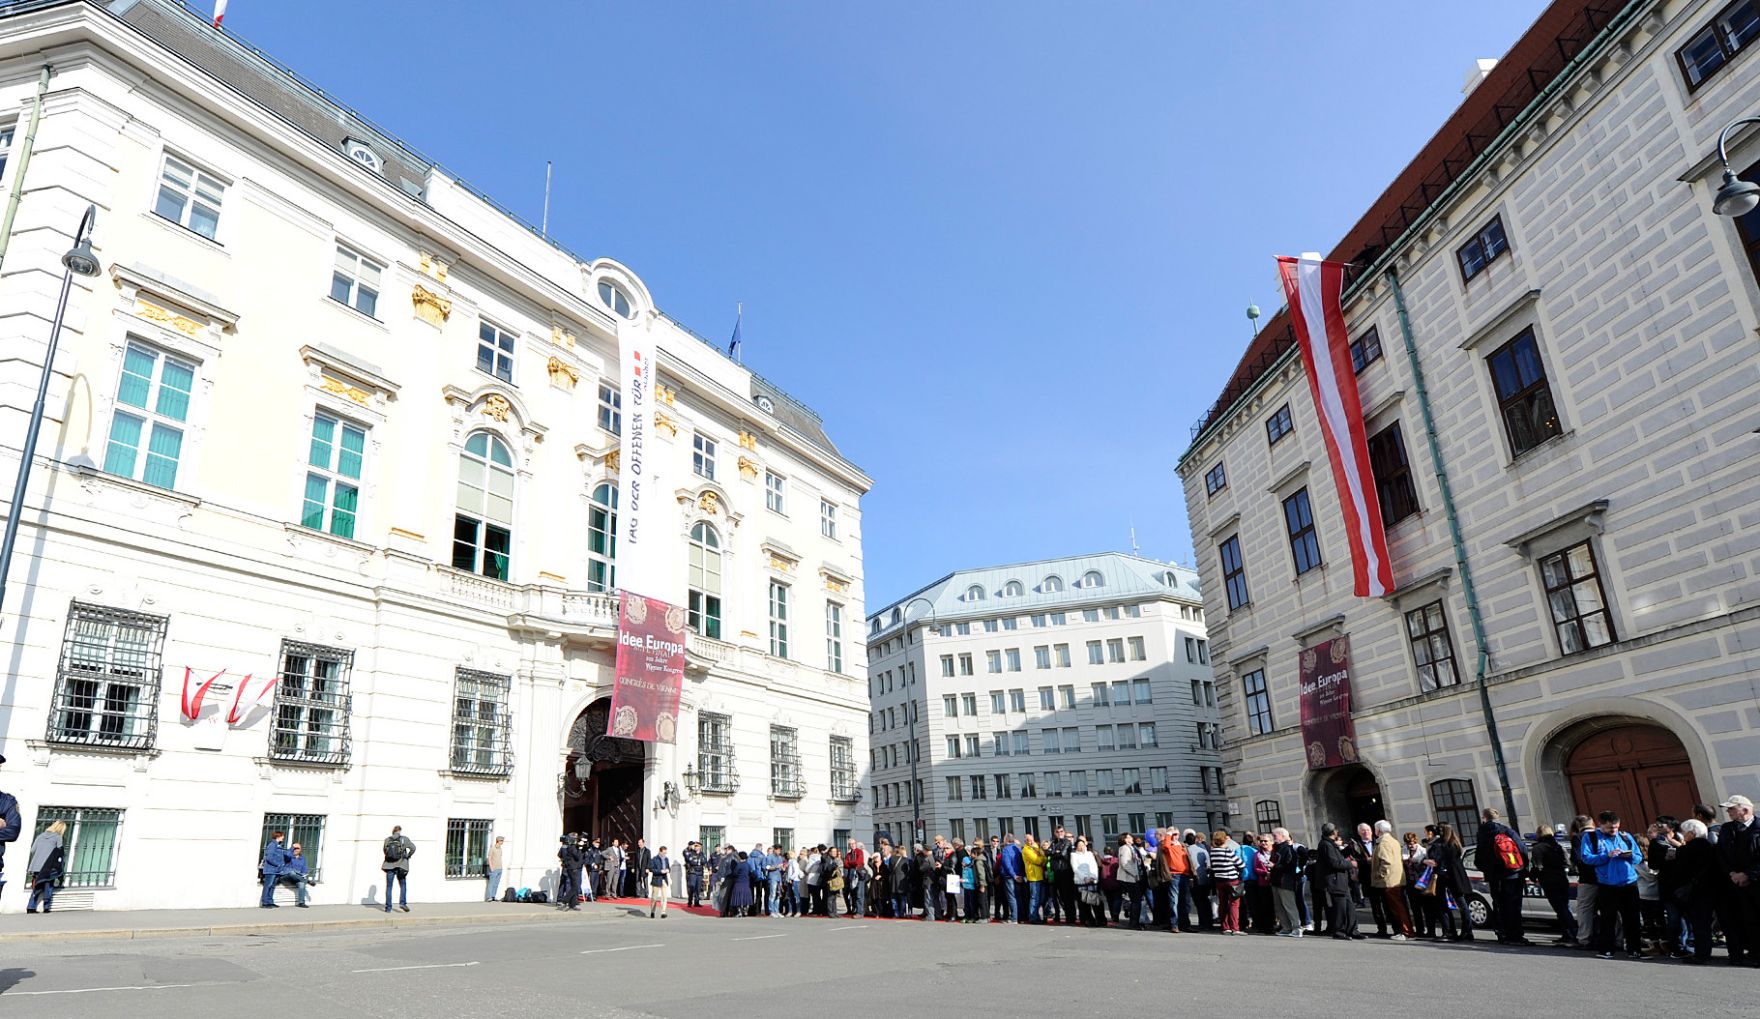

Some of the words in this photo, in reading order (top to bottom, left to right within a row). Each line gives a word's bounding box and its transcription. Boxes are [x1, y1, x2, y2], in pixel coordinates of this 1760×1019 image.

[631, 412, 643, 476] OFFENEN
[619, 630, 643, 647] Idee
[646, 634, 684, 656] Europa
[1300, 682, 1316, 695] Idee
[1318, 669, 1347, 688] Europa
